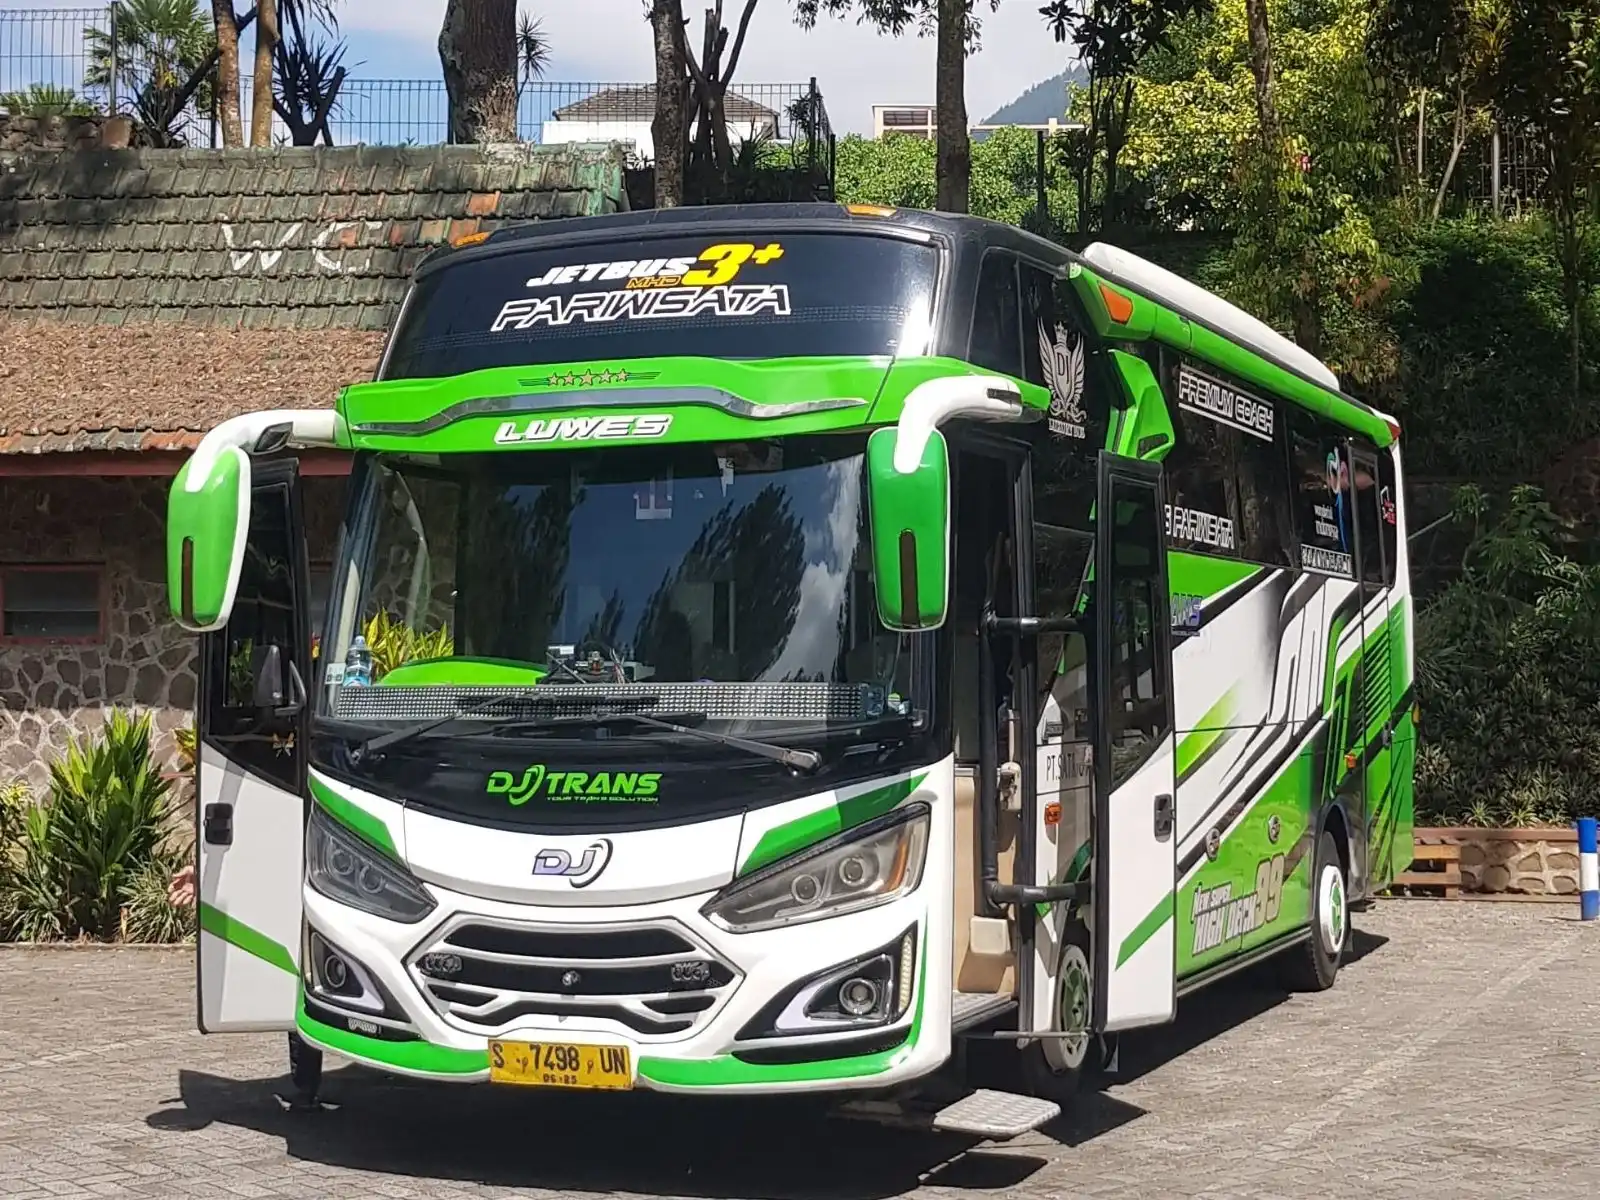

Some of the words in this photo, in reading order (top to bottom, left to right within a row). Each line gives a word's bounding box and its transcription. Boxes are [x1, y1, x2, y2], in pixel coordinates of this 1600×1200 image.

[217, 213, 383, 272] WC
[526, 256, 697, 287] JETBUS
[625, 275, 681, 288] MHD
[490, 285, 791, 332] PARIWISATA
[494, 414, 673, 444] LUWES
[1235, 395, 1274, 434] COACH
[487, 765, 546, 803] DJ
[546, 773, 662, 794] TRANS
[532, 842, 608, 885] DJ
[1255, 853, 1285, 924] 99
[491, 1042, 505, 1068] S
[529, 1043, 580, 1072] 7498
[599, 1047, 626, 1075] UN
